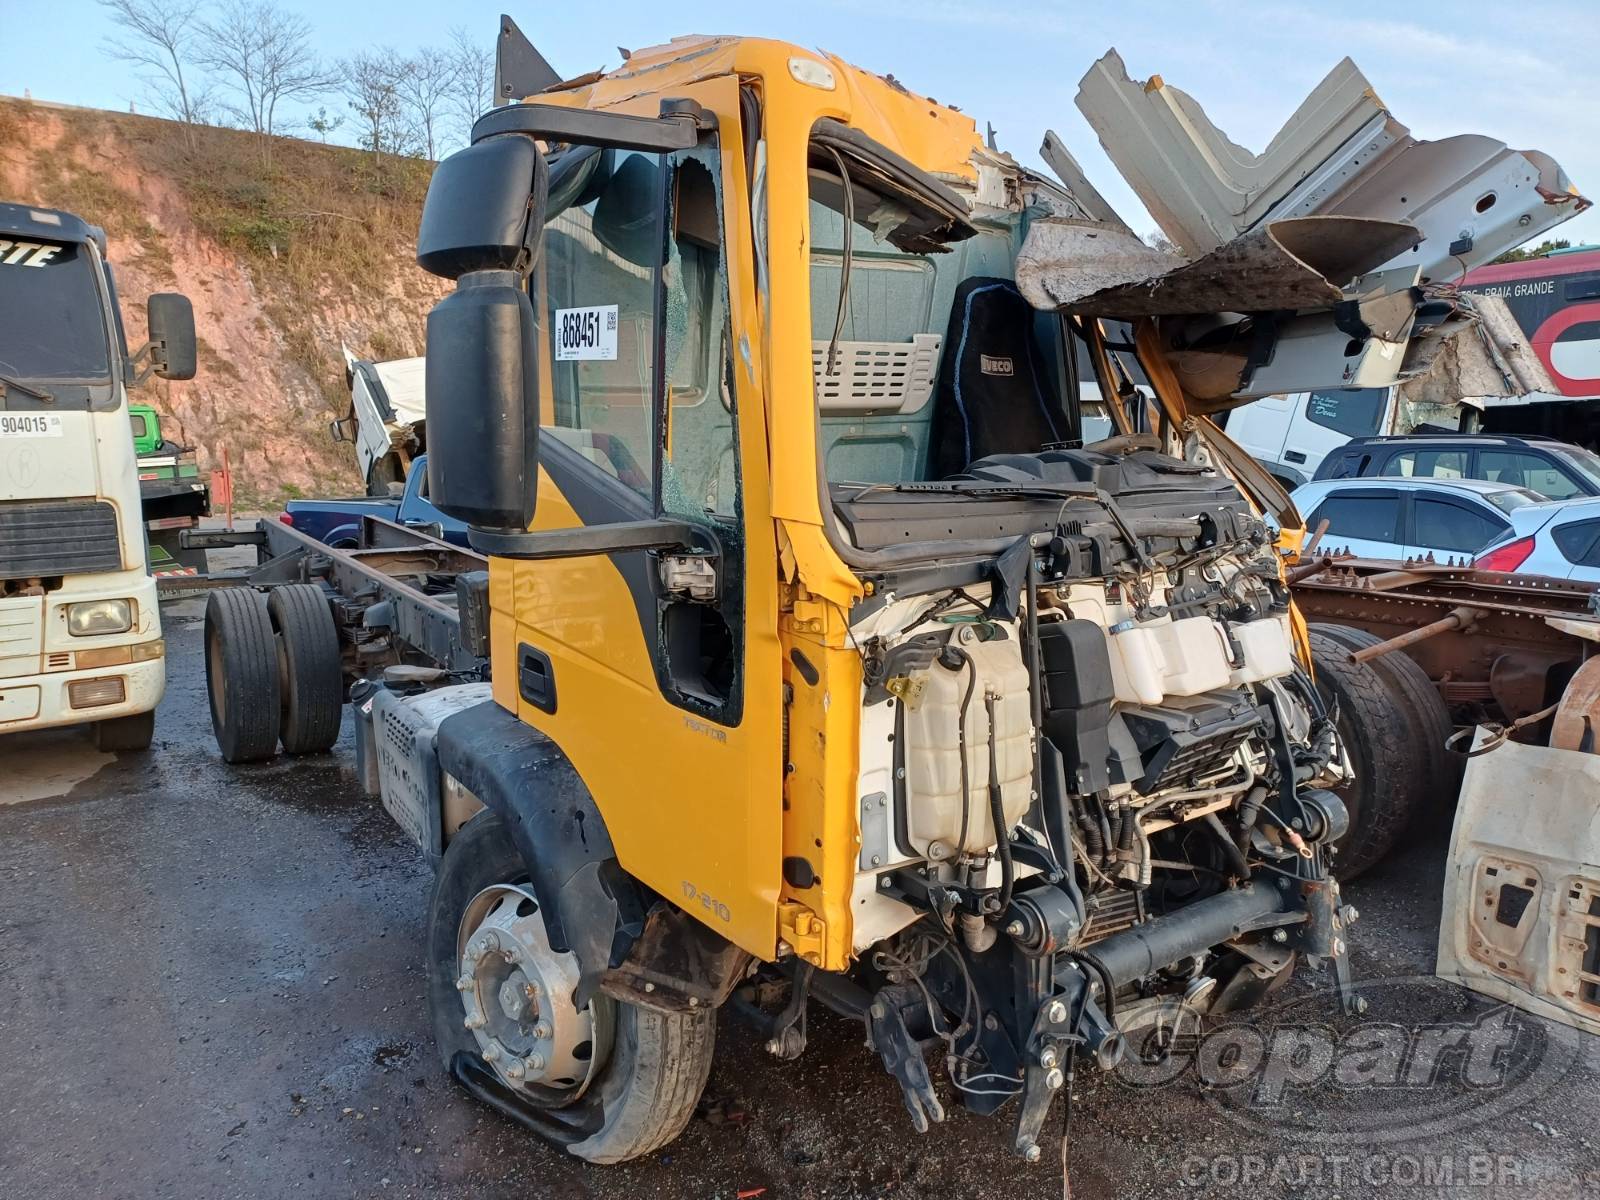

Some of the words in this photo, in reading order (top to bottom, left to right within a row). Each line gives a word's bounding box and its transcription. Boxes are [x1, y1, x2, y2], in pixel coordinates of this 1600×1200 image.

[1485, 286, 1512, 298] PRAIA
[1514, 281, 1555, 297] GRANDE
[563, 311, 600, 348] 868451
[1, 417, 47, 432] 904015
[682, 881, 730, 922] 17-210
